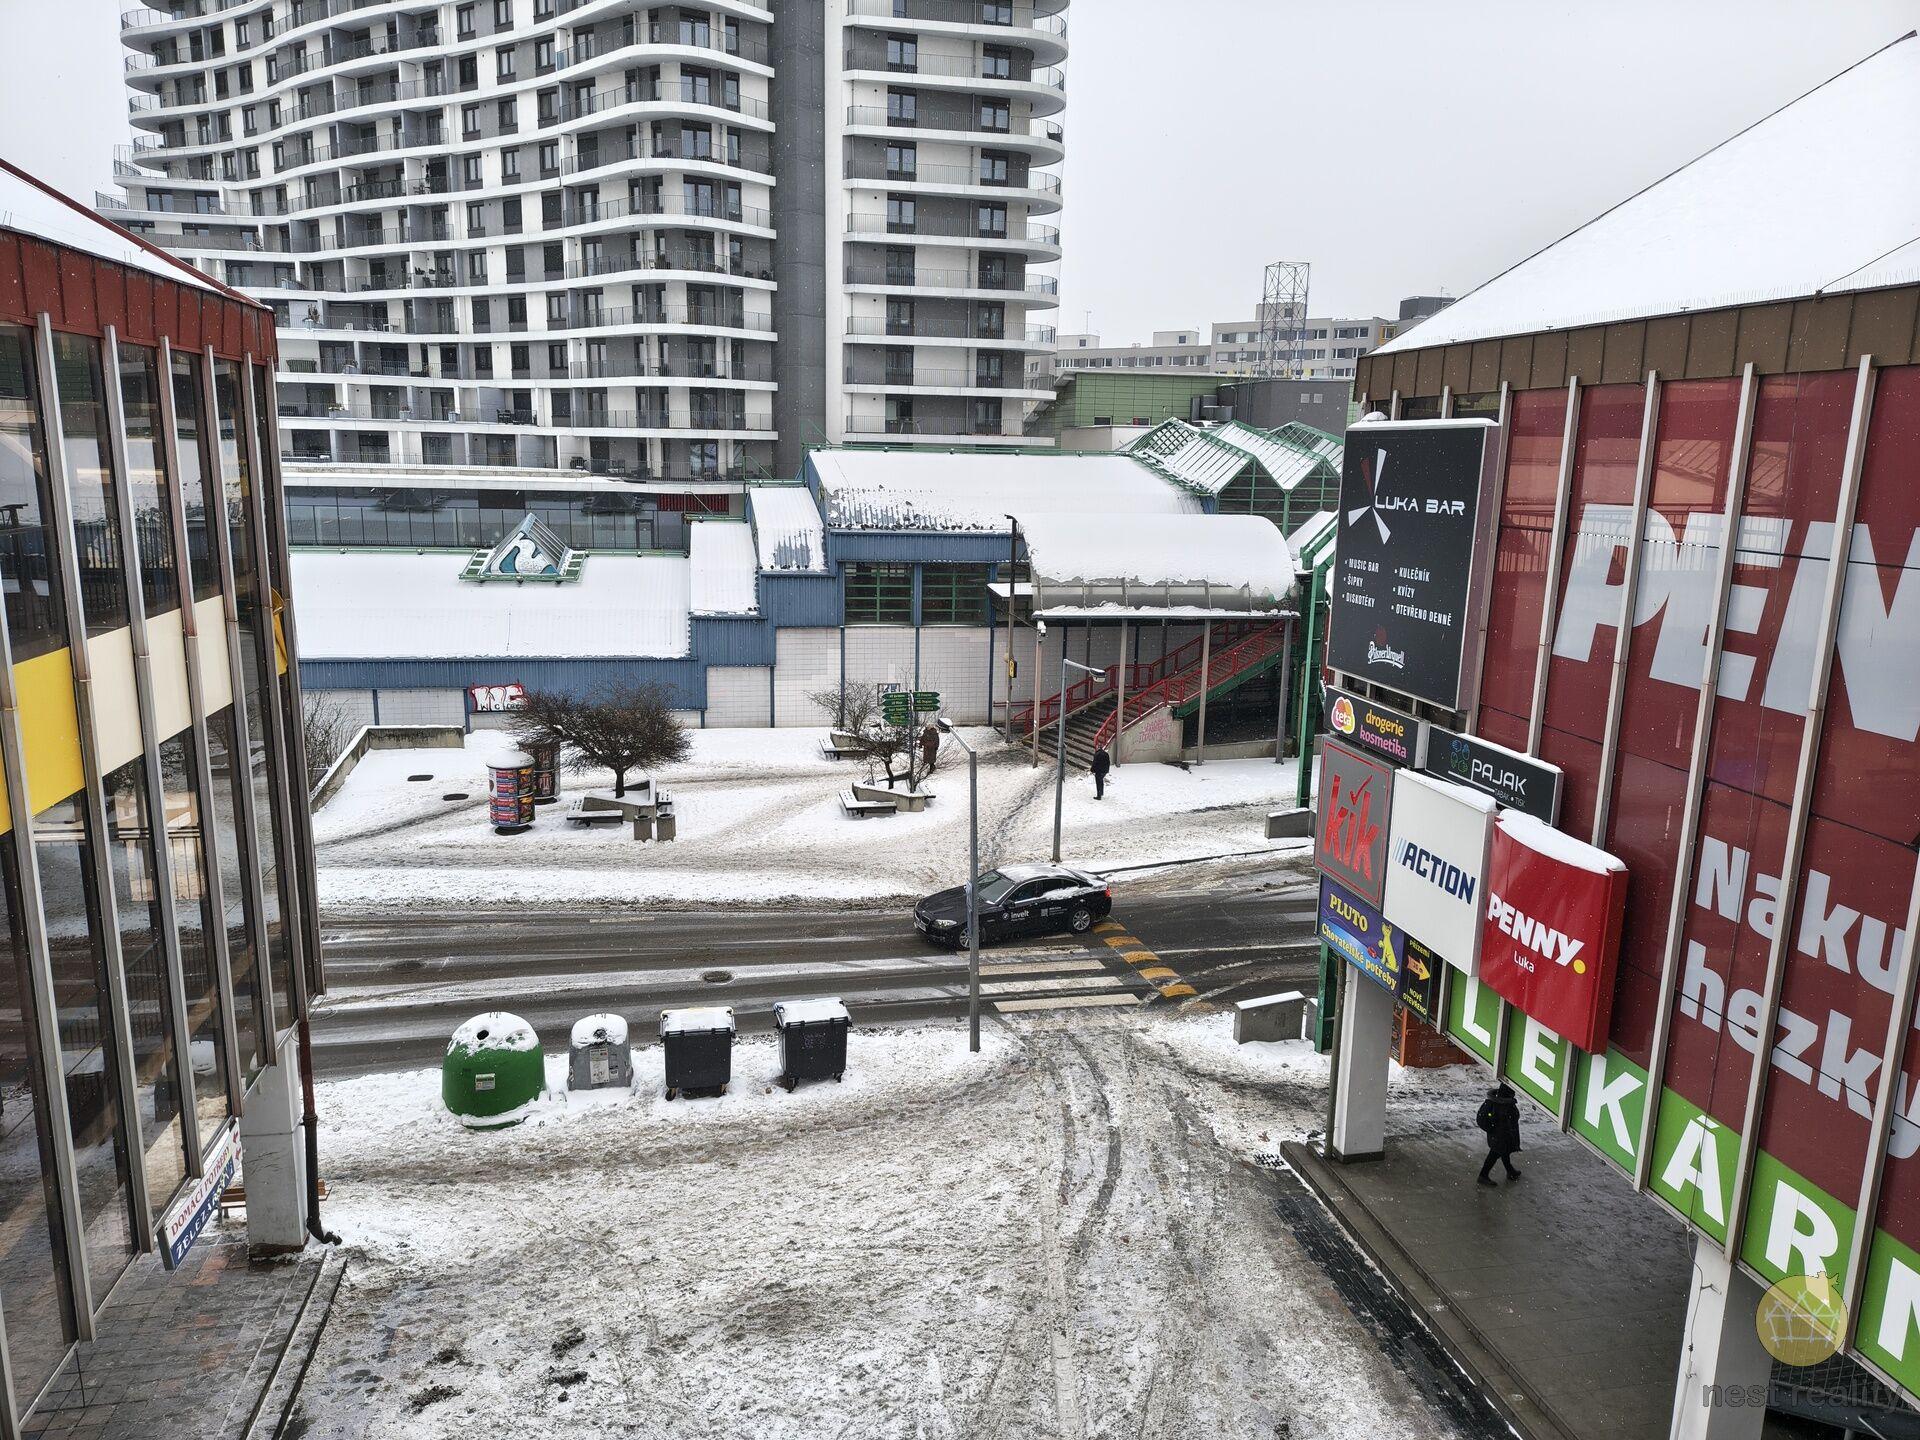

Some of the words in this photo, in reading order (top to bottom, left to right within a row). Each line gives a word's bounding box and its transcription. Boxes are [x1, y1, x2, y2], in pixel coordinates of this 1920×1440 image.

[1375, 495, 1419, 512] LUKA
[1425, 498, 1465, 516] BAR
[1348, 558, 1367, 571] MUSIC
[1367, 561, 1380, 573] BAR
[1399, 566, 1430, 582] KULEČNÍK
[1347, 573, 1364, 588] ŠIPKY
[1397, 584, 1415, 598] KVÍZY
[1346, 592, 1376, 608] DISKOTÉKY
[1396, 604, 1427, 621] OTEVŘENO
[1428, 612, 1452, 626] DENNĚ
[1335, 710, 1352, 726] teta
[1366, 709, 1404, 737] drogerie
[1360, 725, 1407, 758] kosmetika
[1470, 758, 1527, 796] PAJAK
[1402, 842, 1476, 905] ACTION
[1330, 894, 1368, 932] PLUTO
[1695, 836, 1920, 1030] Naku
[1322, 922, 1364, 963] Chovatelské
[1365, 960, 1396, 990] potřeby
[1514, 950, 1534, 974] Luka
